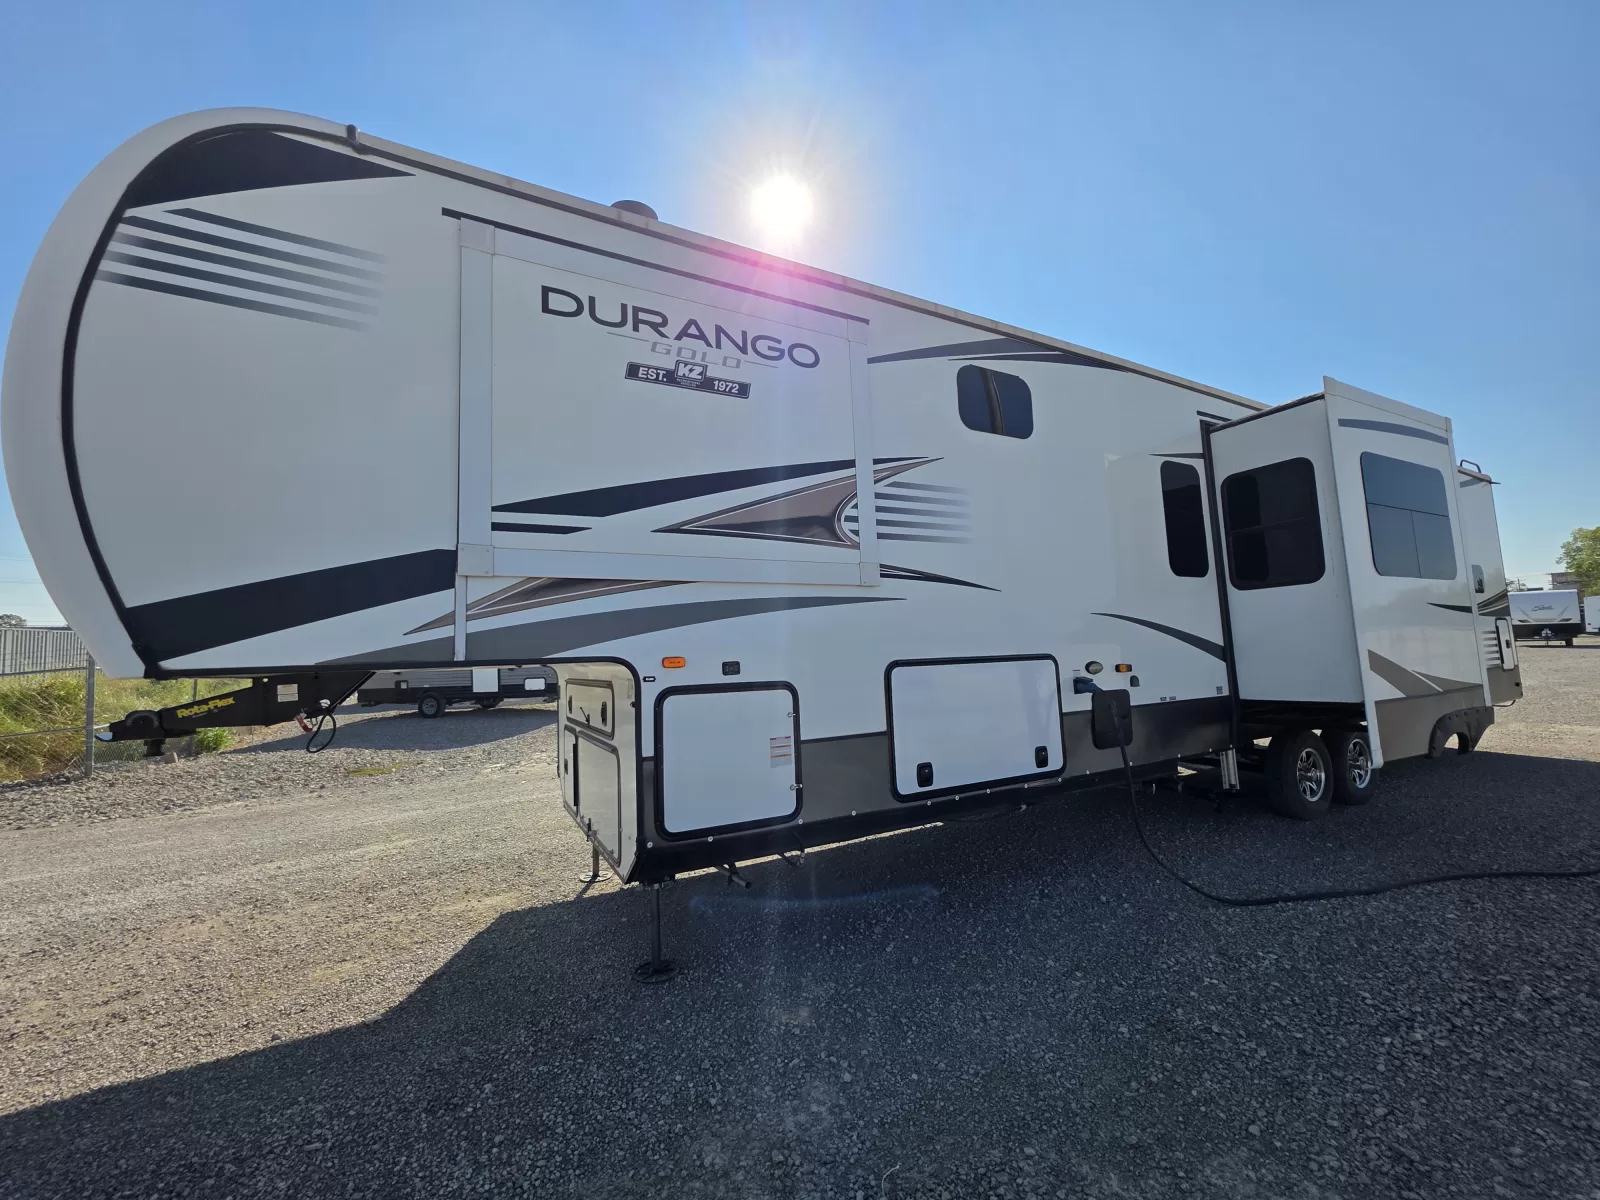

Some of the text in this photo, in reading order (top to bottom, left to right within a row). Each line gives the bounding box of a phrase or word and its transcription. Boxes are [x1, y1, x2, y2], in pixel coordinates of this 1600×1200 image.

[540, 285, 821, 369] DURANGO
[650, 341, 742, 369] GOLD
[637, 366, 667, 382] EST.
[677, 362, 704, 380] KZ
[712, 379, 740, 394] 1972
